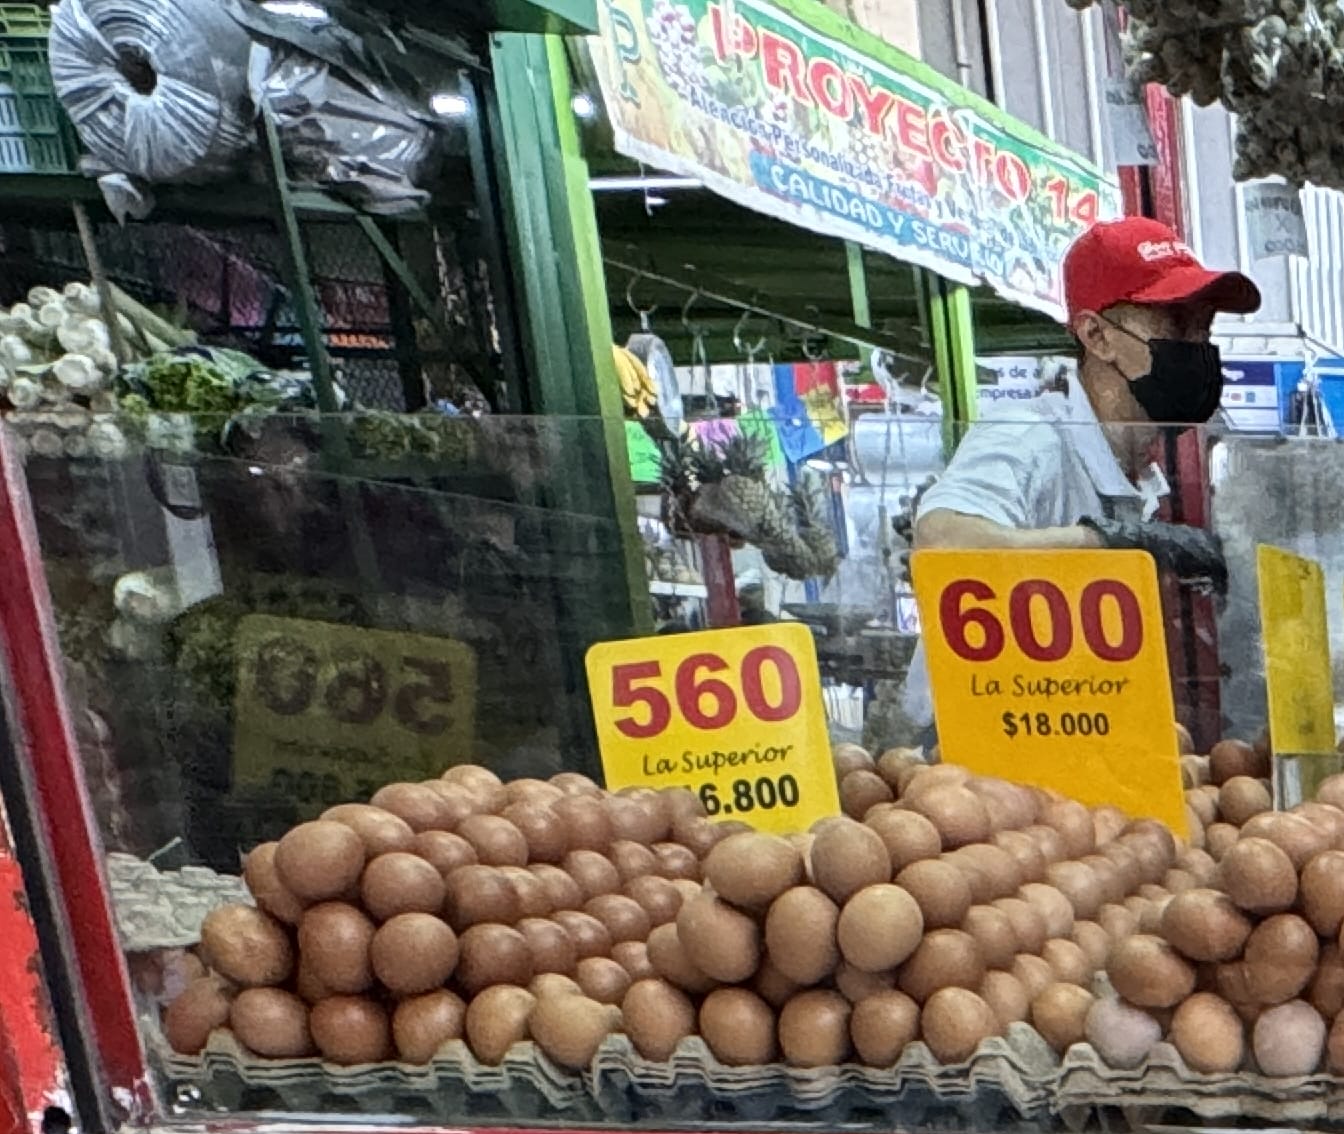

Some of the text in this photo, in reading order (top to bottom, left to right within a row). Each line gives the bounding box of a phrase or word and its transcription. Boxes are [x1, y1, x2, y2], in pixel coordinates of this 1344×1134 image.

[770, 165, 882, 228] CALIDAD
[887, 211, 904, 234] Y
[939, 578, 1145, 662] 600
[612, 646, 804, 738] 560
[970, 674, 1130, 701] La Superior
[1002, 712, 1109, 739] $18.000
[643, 741, 795, 776] La Superior
[685, 774, 800, 817] 6.800
